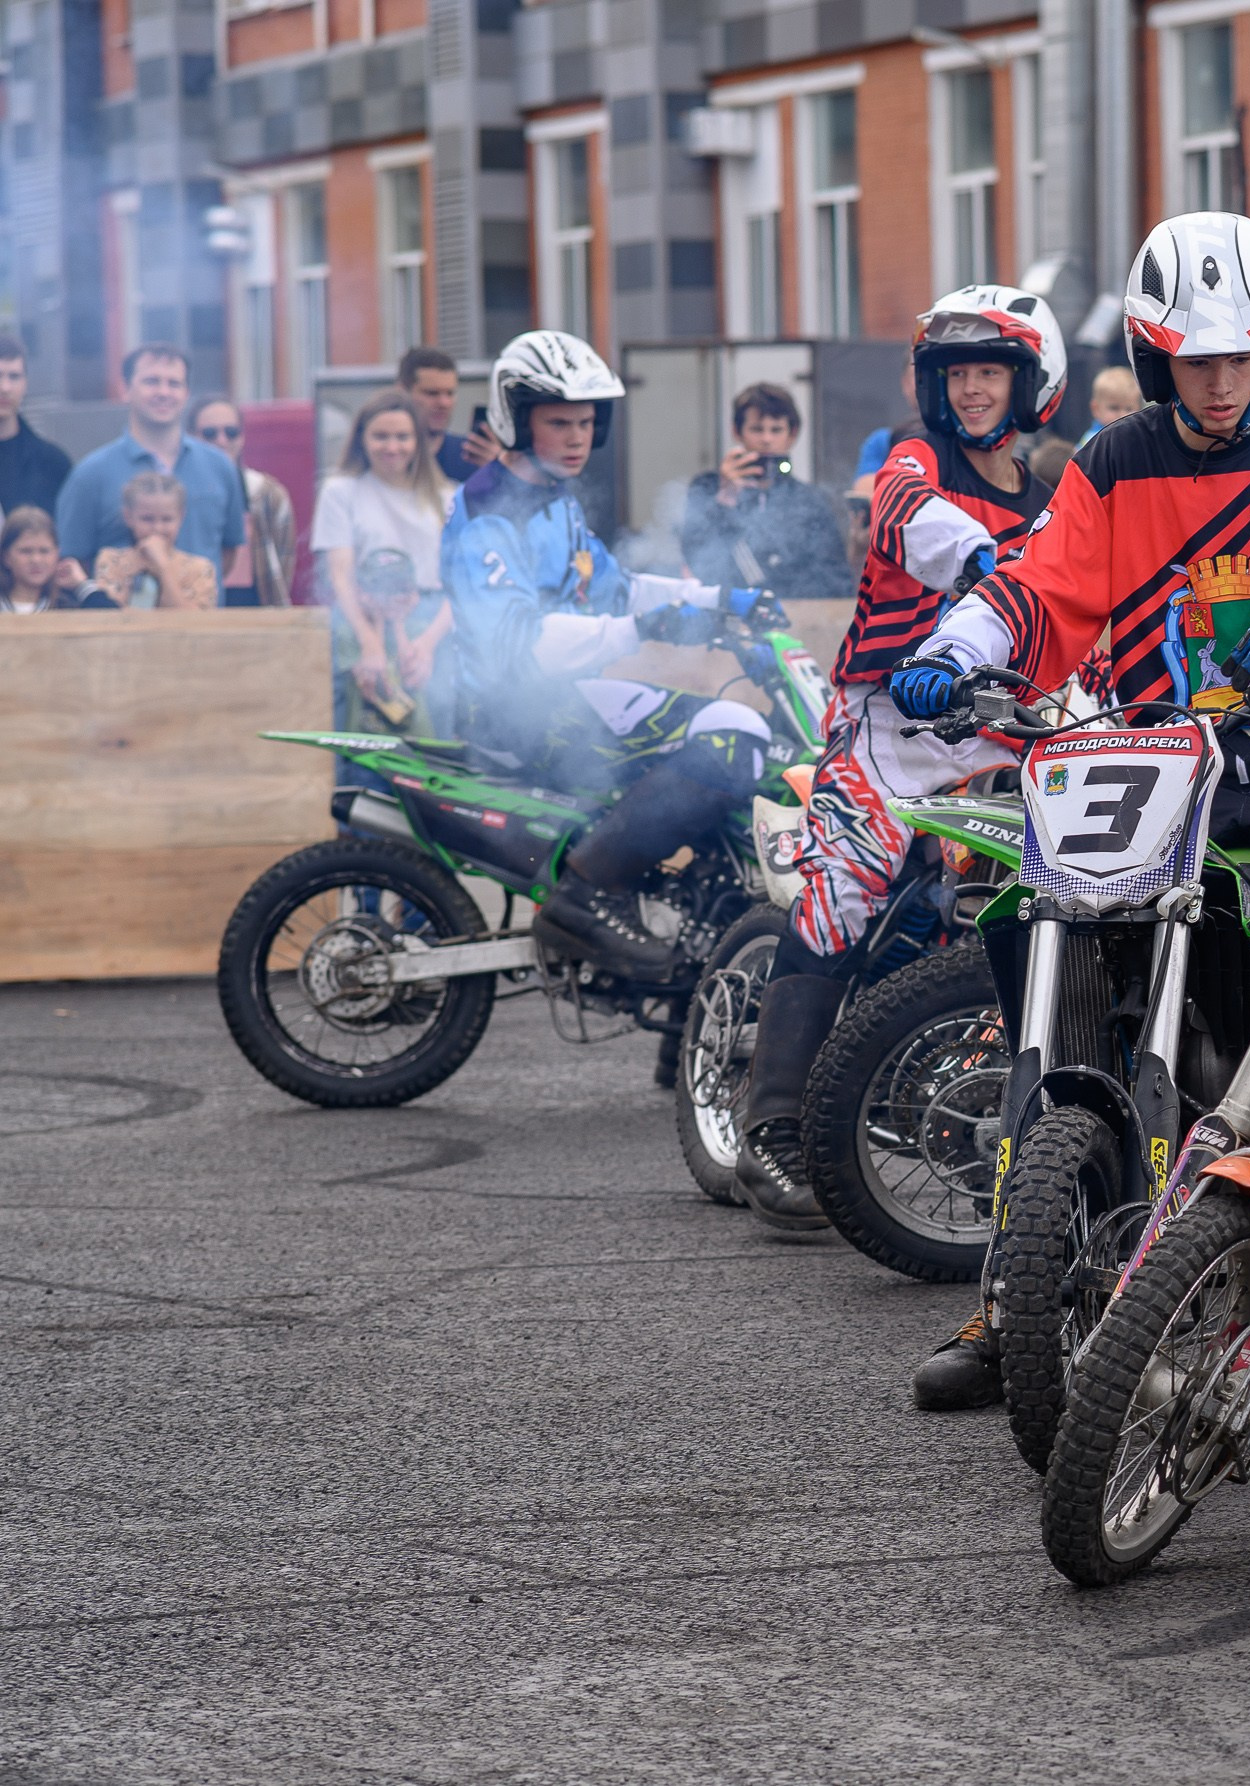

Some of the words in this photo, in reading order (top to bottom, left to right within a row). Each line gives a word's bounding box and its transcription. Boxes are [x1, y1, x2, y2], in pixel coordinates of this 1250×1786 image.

[1043, 736, 1133, 755] МОТОДРОМ
[1134, 736, 1192, 750] АРЕНА
[1056, 765, 1161, 855] 3
[963, 819, 1024, 848] DUNL
[1191, 1126, 1230, 1149] KTM
